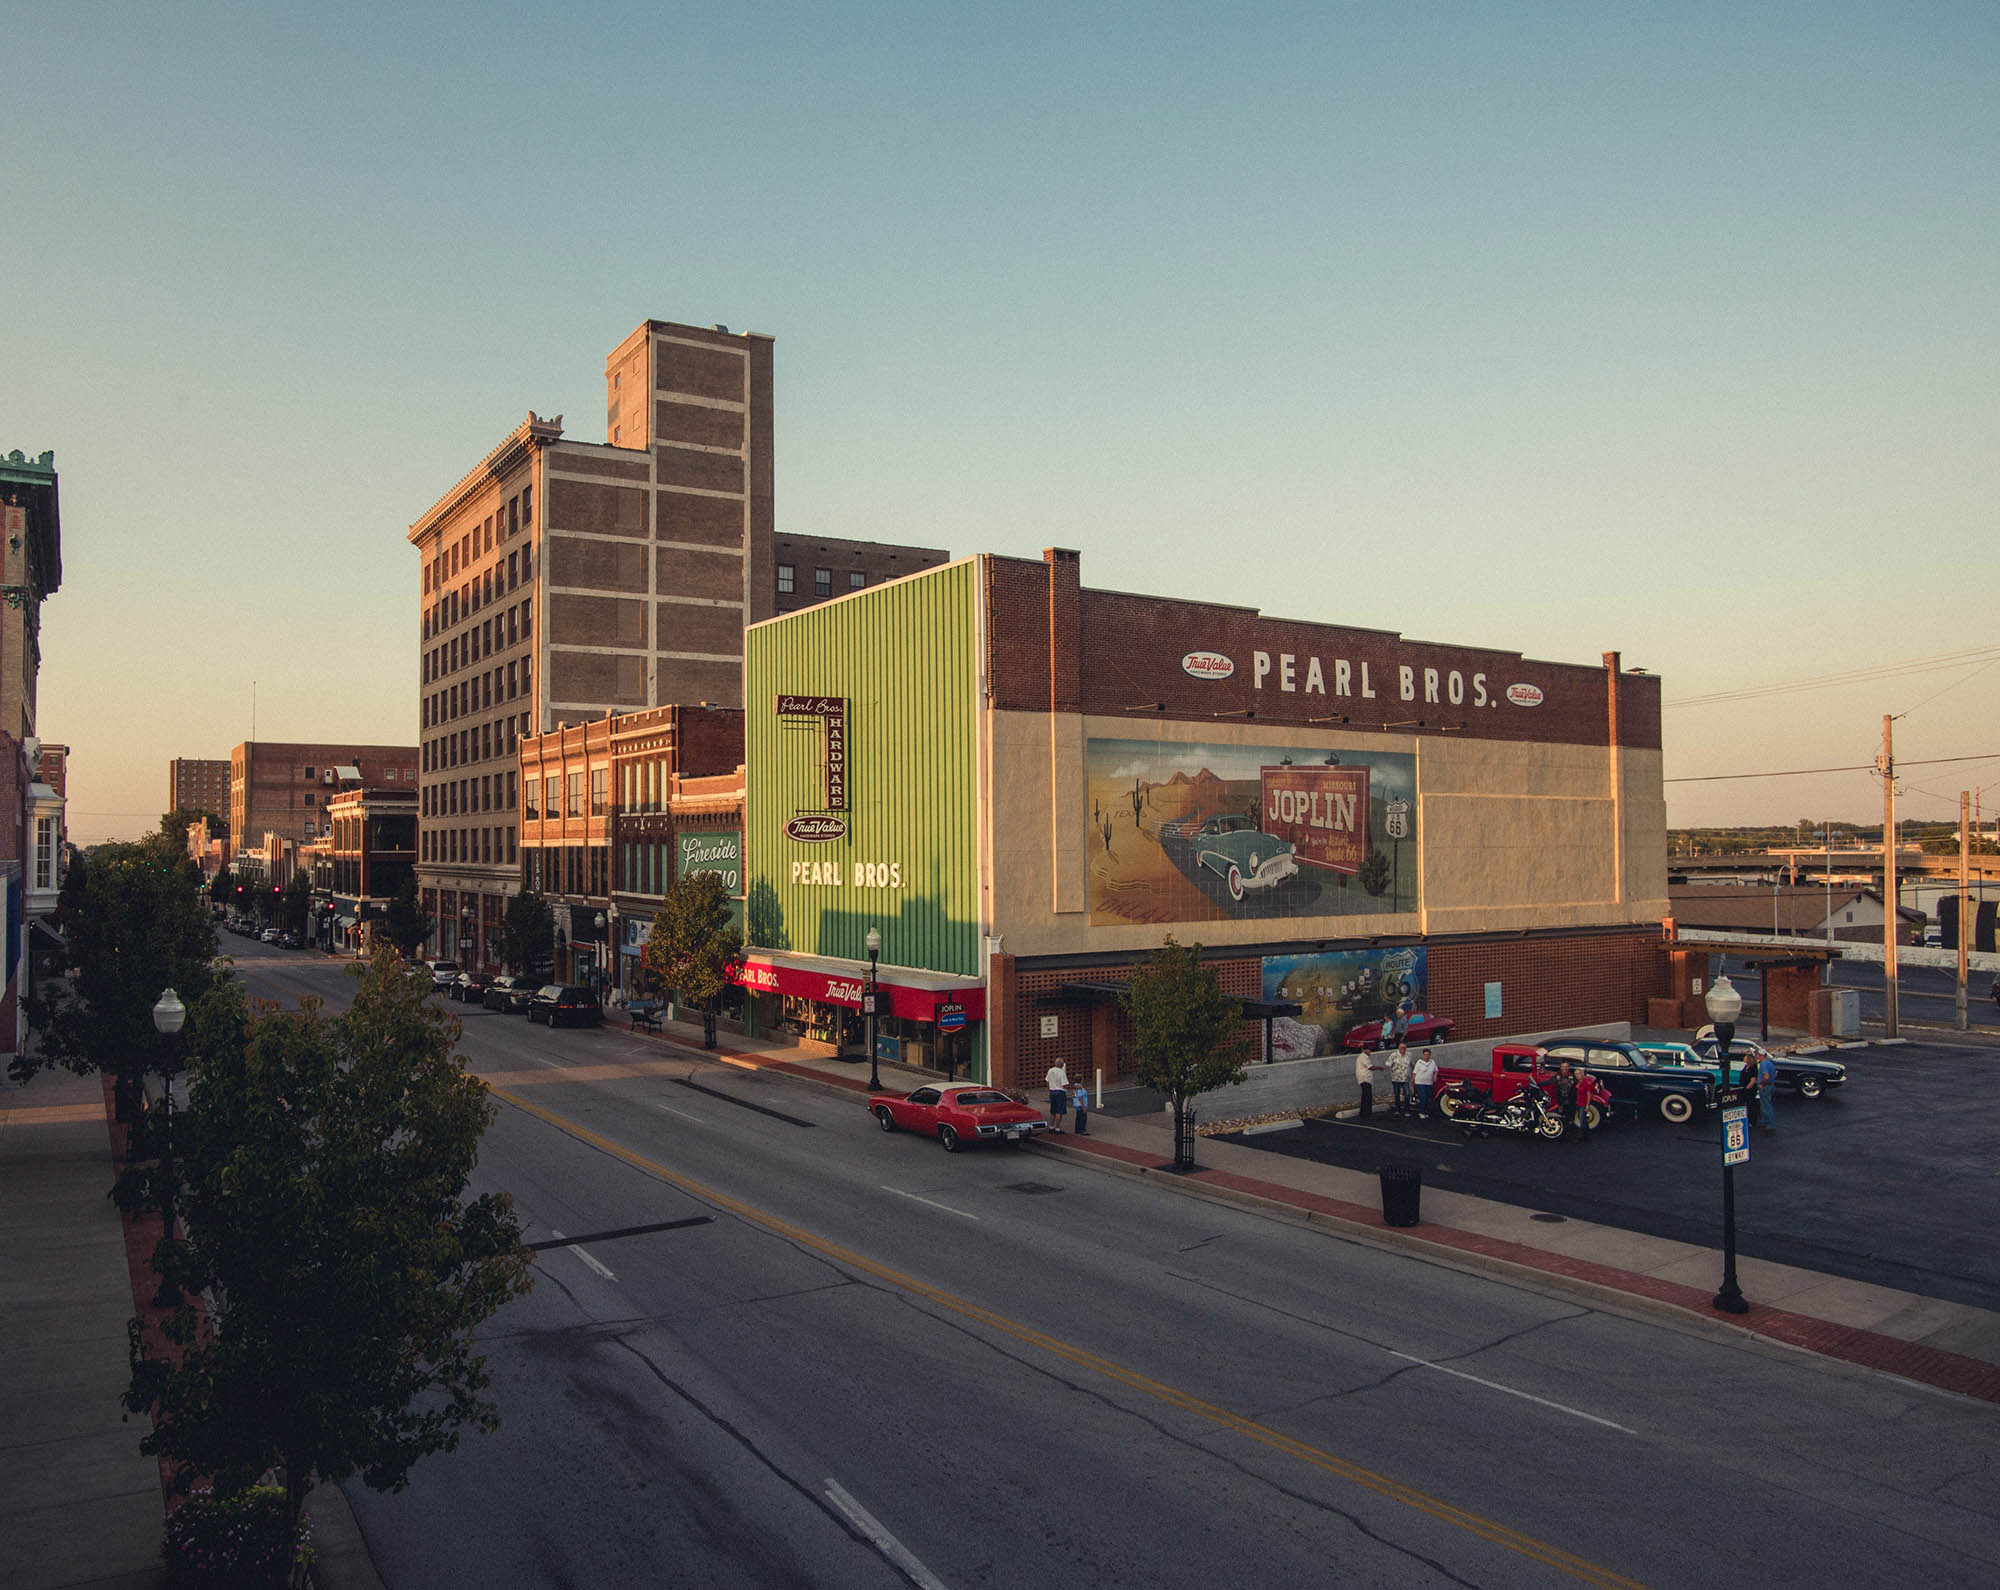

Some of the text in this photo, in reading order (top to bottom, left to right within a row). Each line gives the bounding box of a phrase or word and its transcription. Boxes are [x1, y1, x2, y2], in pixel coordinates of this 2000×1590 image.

[1253, 651, 1496, 708] PEARL BROS.
[781, 697, 843, 714] Pearl Bros.
[829, 718, 843, 806] HARDWARE
[1269, 789, 1357, 832] JOPLIN
[1390, 821, 1401, 835] 66
[683, 838, 737, 875] Fireside
[792, 861, 907, 888] PEARL BROS.
[1385, 958, 1411, 969] ROUTE
[1385, 972, 1410, 998] 66
[941, 1004, 962, 1013] JOPLIN
[1722, 1095, 1737, 1104] JOPLIN
[1724, 1109, 1745, 1119] HISTORIC
[1731, 1135, 1741, 1147] 66
[1728, 1151, 1745, 1162] BYWAY
